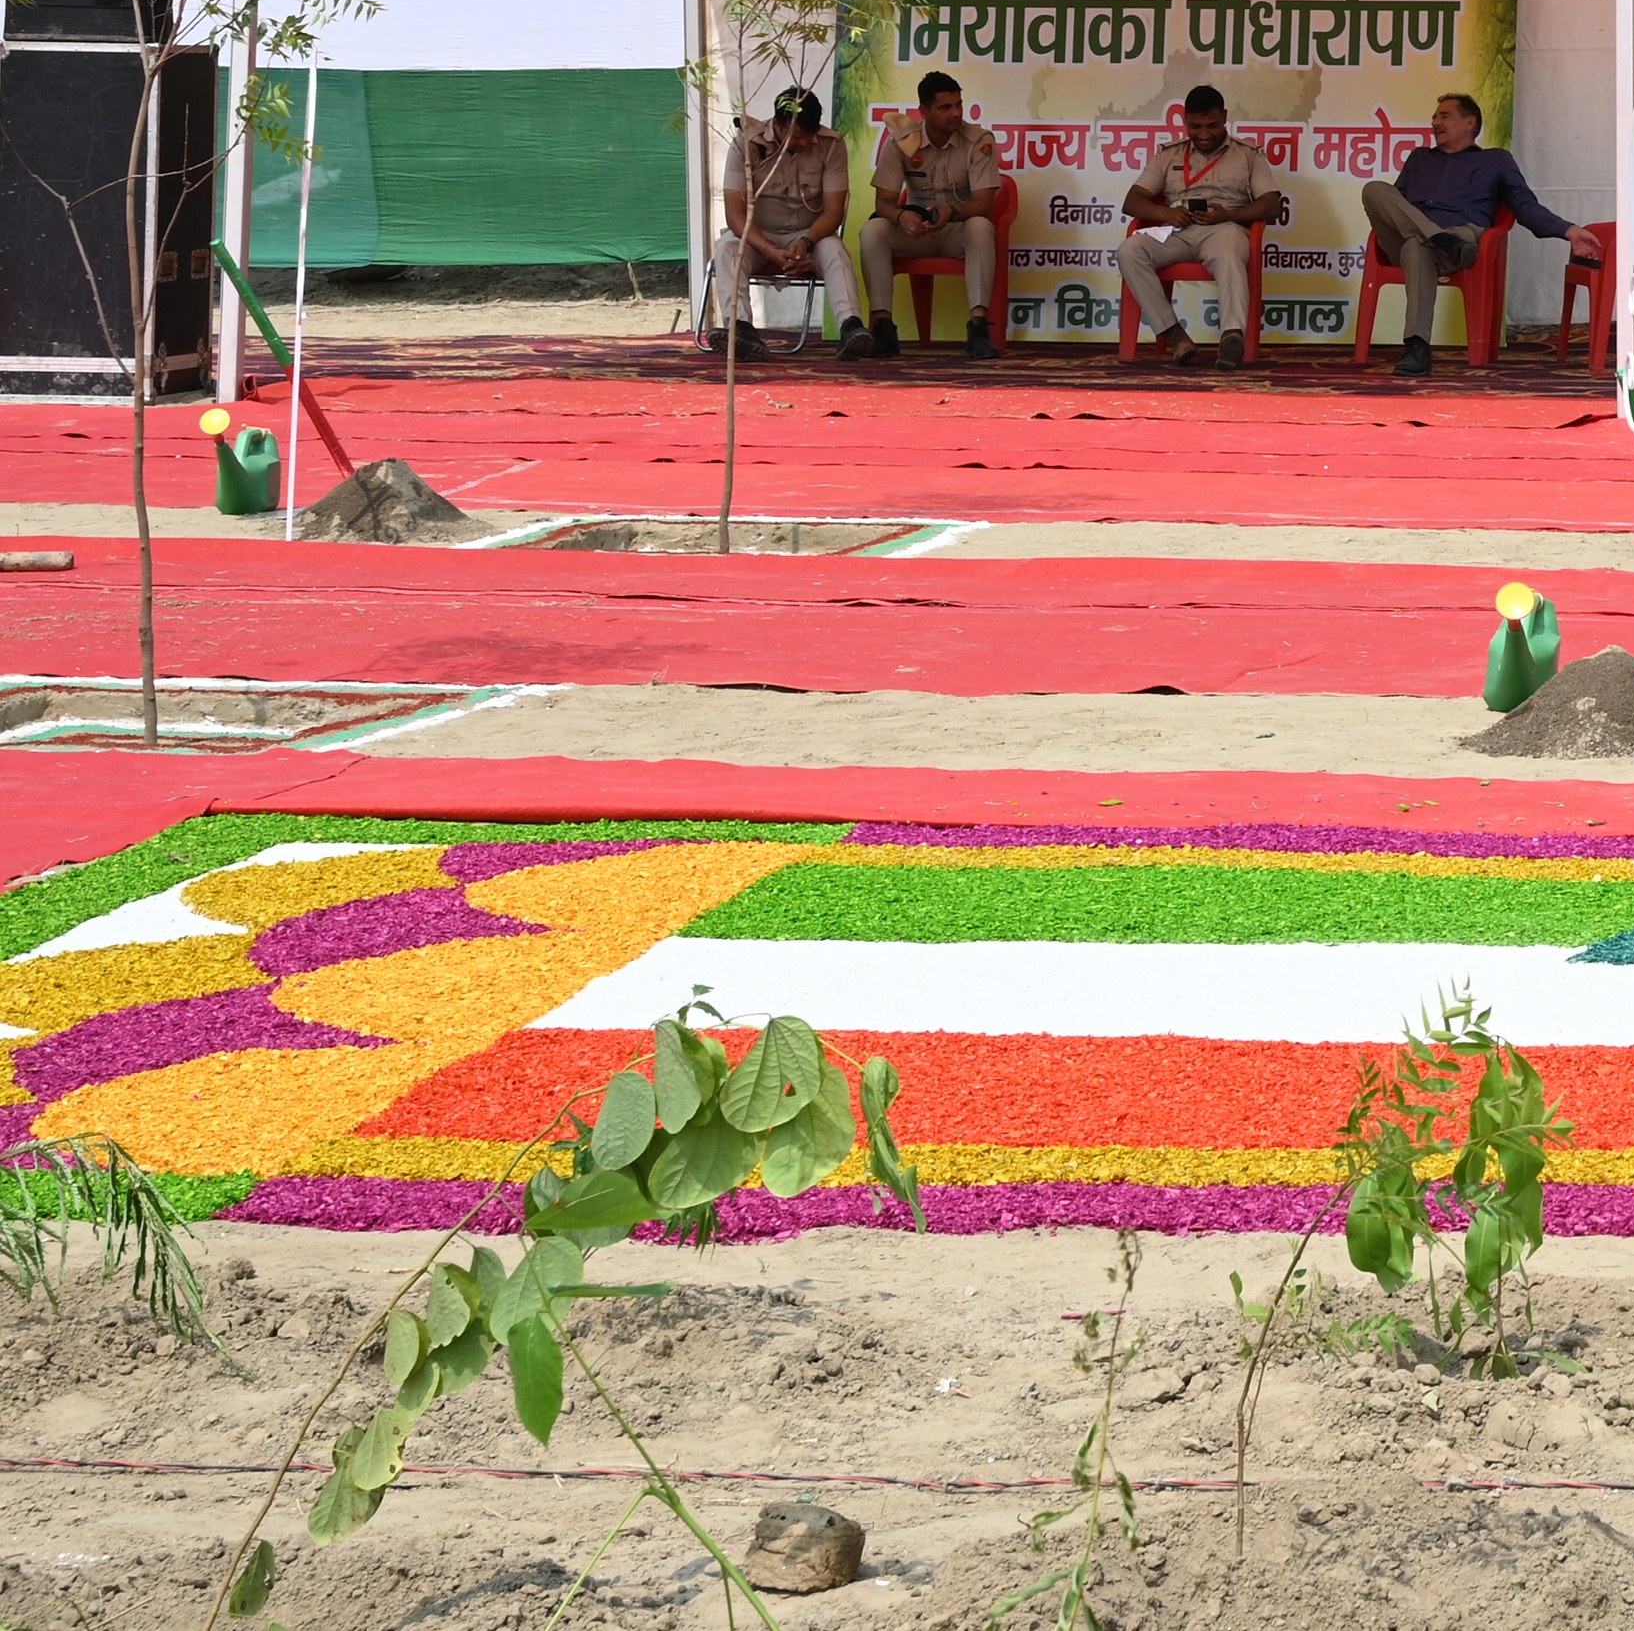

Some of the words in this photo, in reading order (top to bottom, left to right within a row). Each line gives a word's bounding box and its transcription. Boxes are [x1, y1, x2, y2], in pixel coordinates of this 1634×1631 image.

[992, 125, 1090, 170] राज्य
[1050, 195, 1114, 225] दिनांक
[1035, 249, 1102, 267] उपाध्याय
